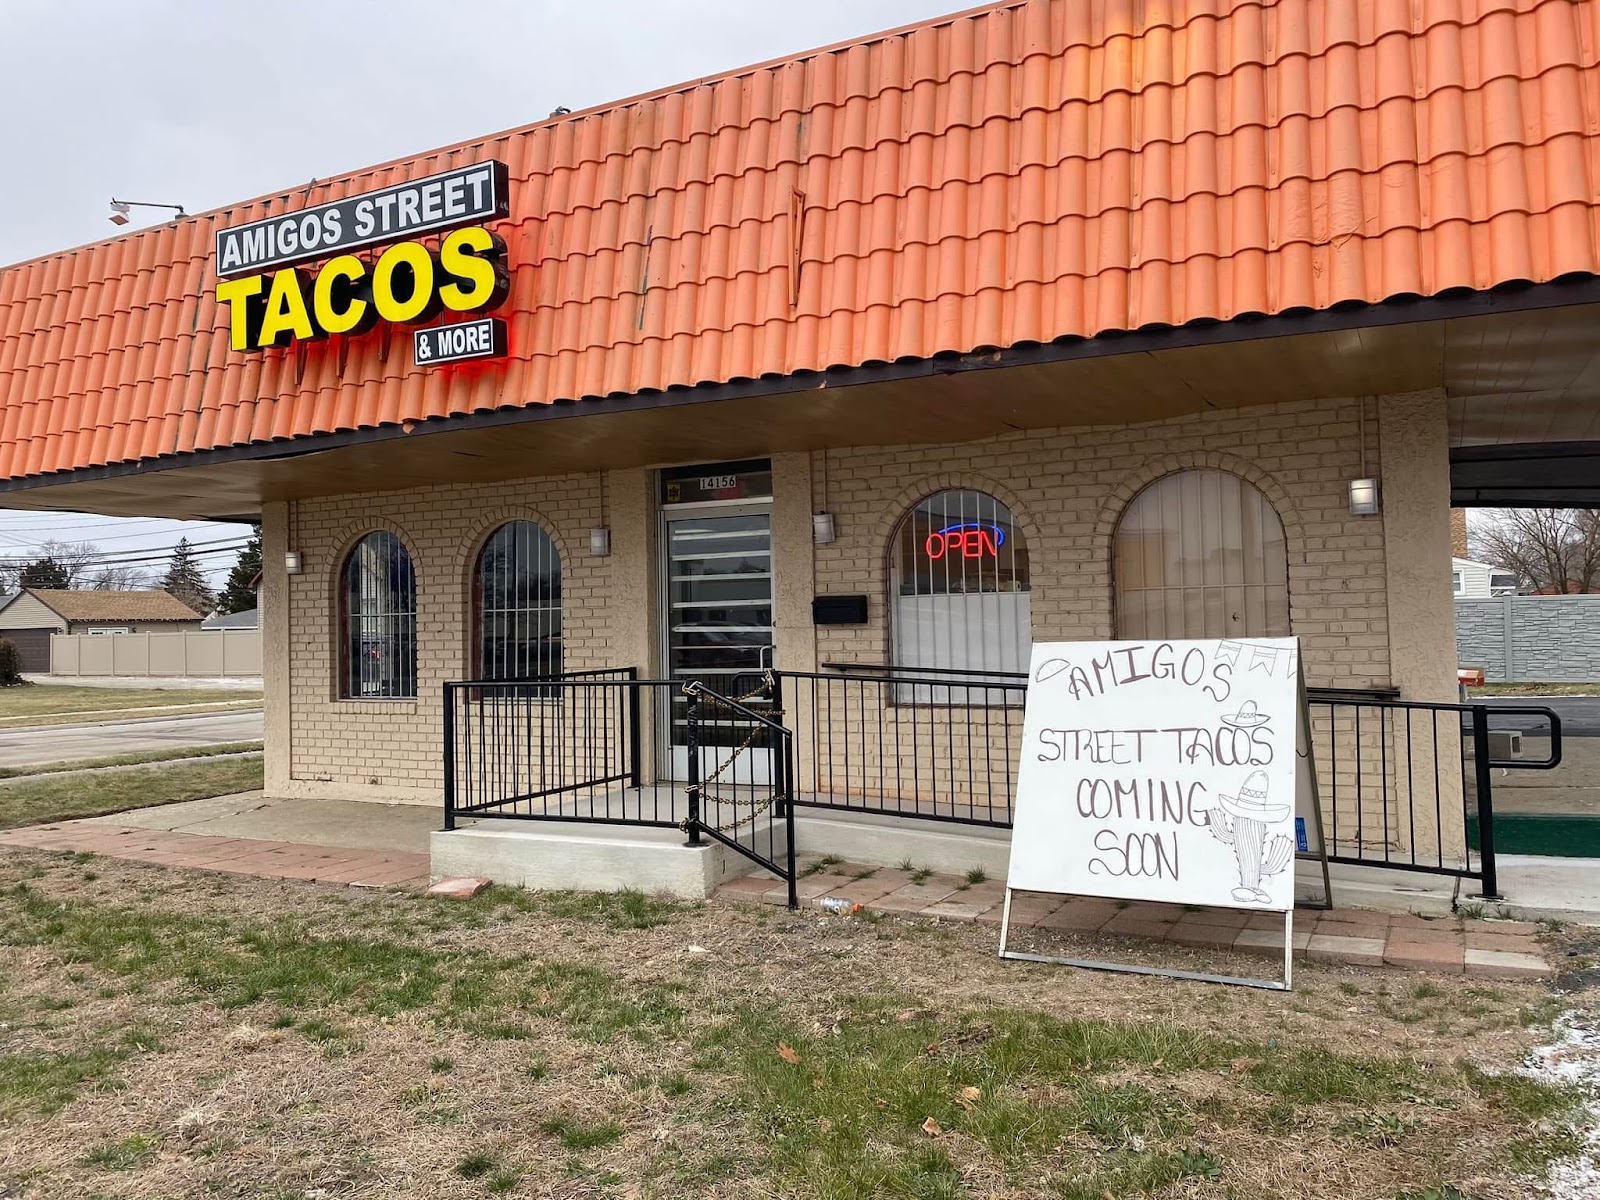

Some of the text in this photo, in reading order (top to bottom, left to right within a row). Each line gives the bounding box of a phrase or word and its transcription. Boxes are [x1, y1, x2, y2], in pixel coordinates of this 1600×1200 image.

[221, 170, 489, 269] AMIGOS STREET
[215, 226, 496, 351] TACOS
[418, 324, 491, 359] & MORE
[702, 475, 735, 489] 14156
[925, 530, 998, 559] OPEN
[1068, 643, 1233, 703] AMIGOS
[1037, 726, 1274, 767] STREET TACOS
[1076, 778, 1212, 827] COMING
[1088, 829, 1179, 881] SOON
